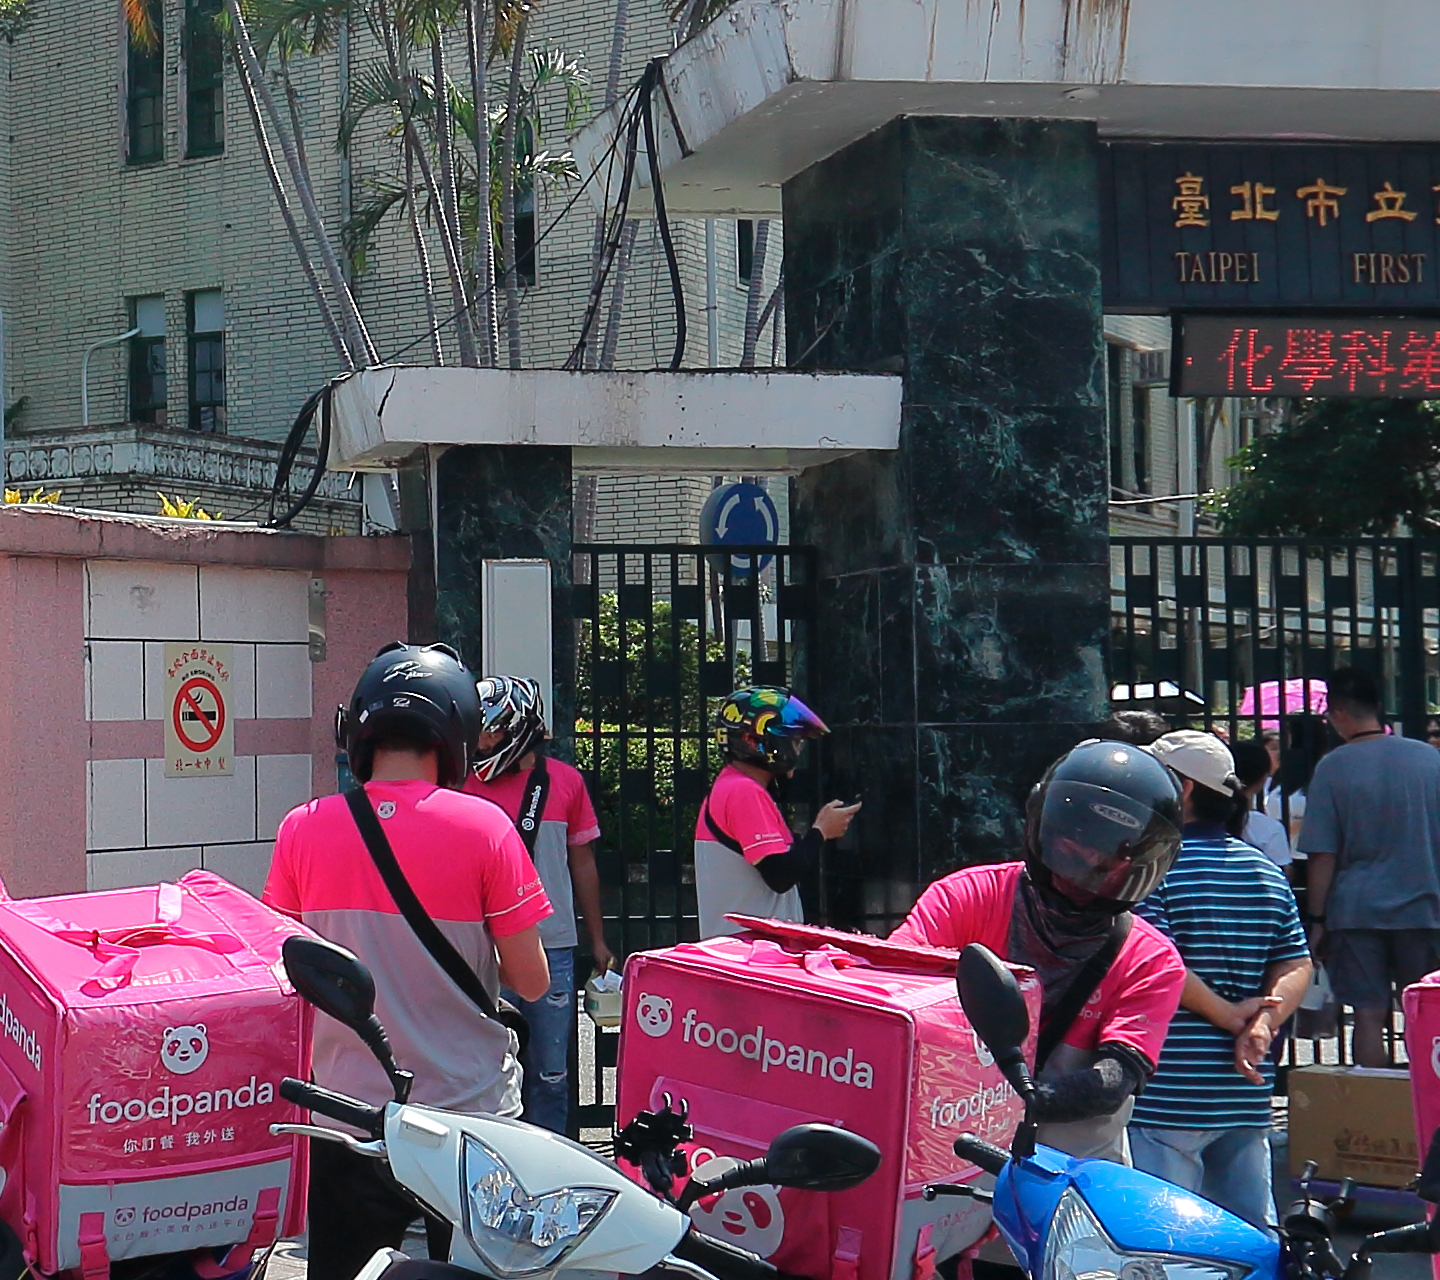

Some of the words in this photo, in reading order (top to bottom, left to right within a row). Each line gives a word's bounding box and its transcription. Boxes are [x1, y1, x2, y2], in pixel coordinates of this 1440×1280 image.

[1175, 252, 1260, 283] TAIPEI
[1354, 252, 1427, 284] FIRST
[682, 1008, 876, 1090] foodpanda
[87, 1076, 274, 1125] foodpanda
[123, 1135, 175, 1154] 你訂餐
[185, 1127, 235, 1147] 我外送
[142, 1195, 249, 1223] foodpanda
